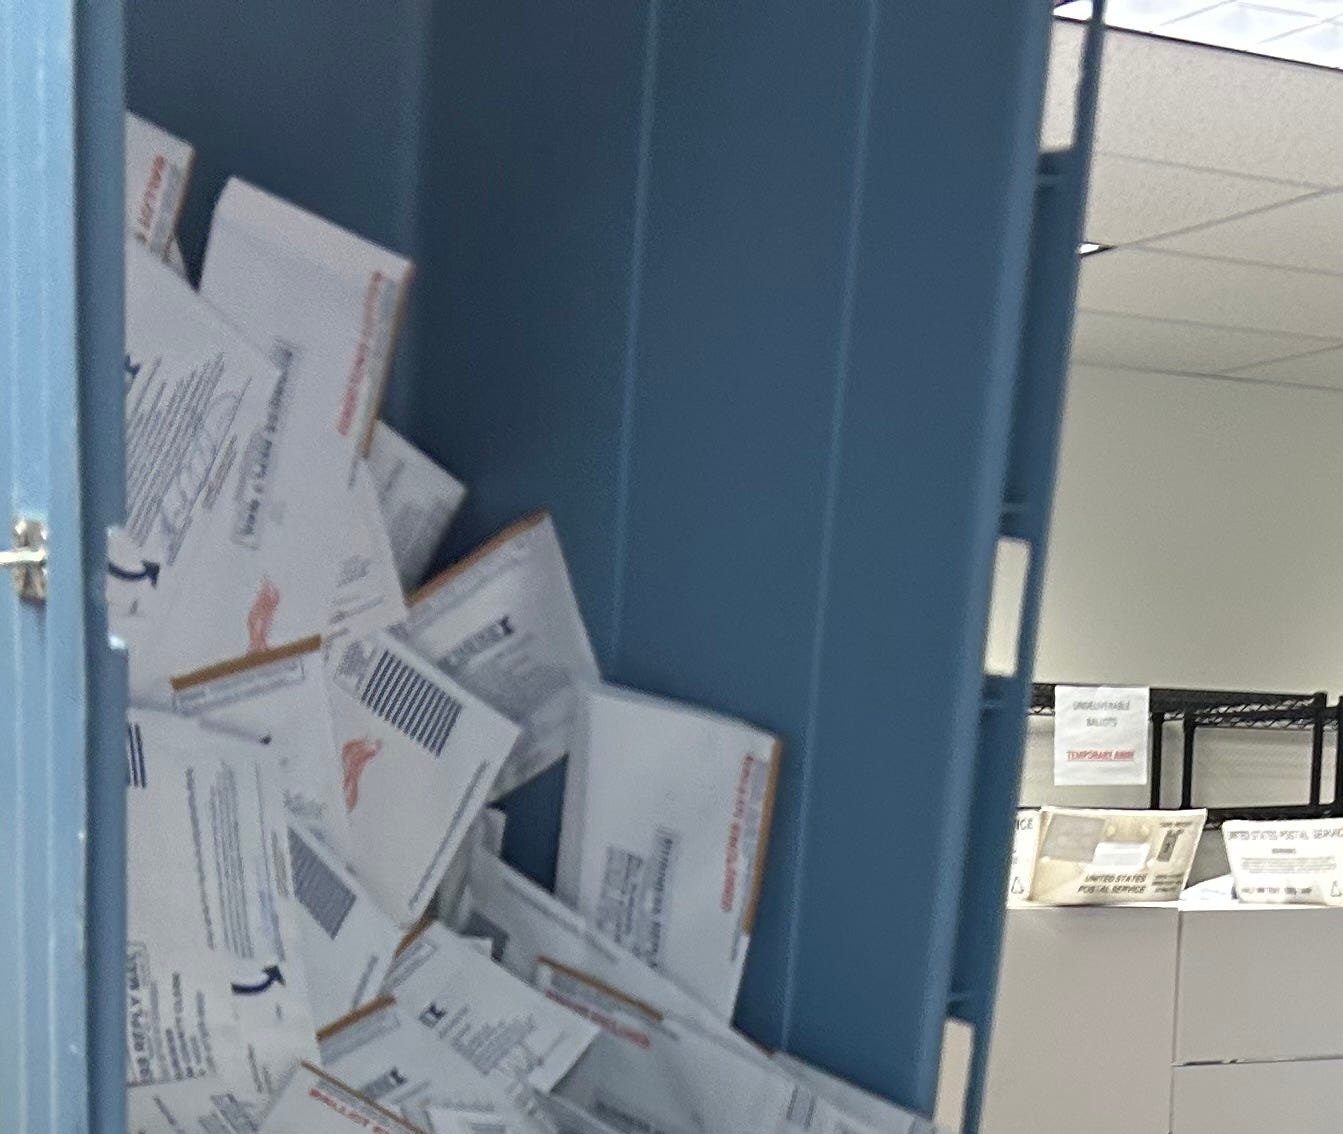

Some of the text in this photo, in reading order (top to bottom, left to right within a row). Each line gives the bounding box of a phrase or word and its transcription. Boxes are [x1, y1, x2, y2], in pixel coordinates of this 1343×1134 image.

[1084, 872, 1148, 883] UNITED STATES
[1077, 884, 1146, 895] POSTAL SERVICE
